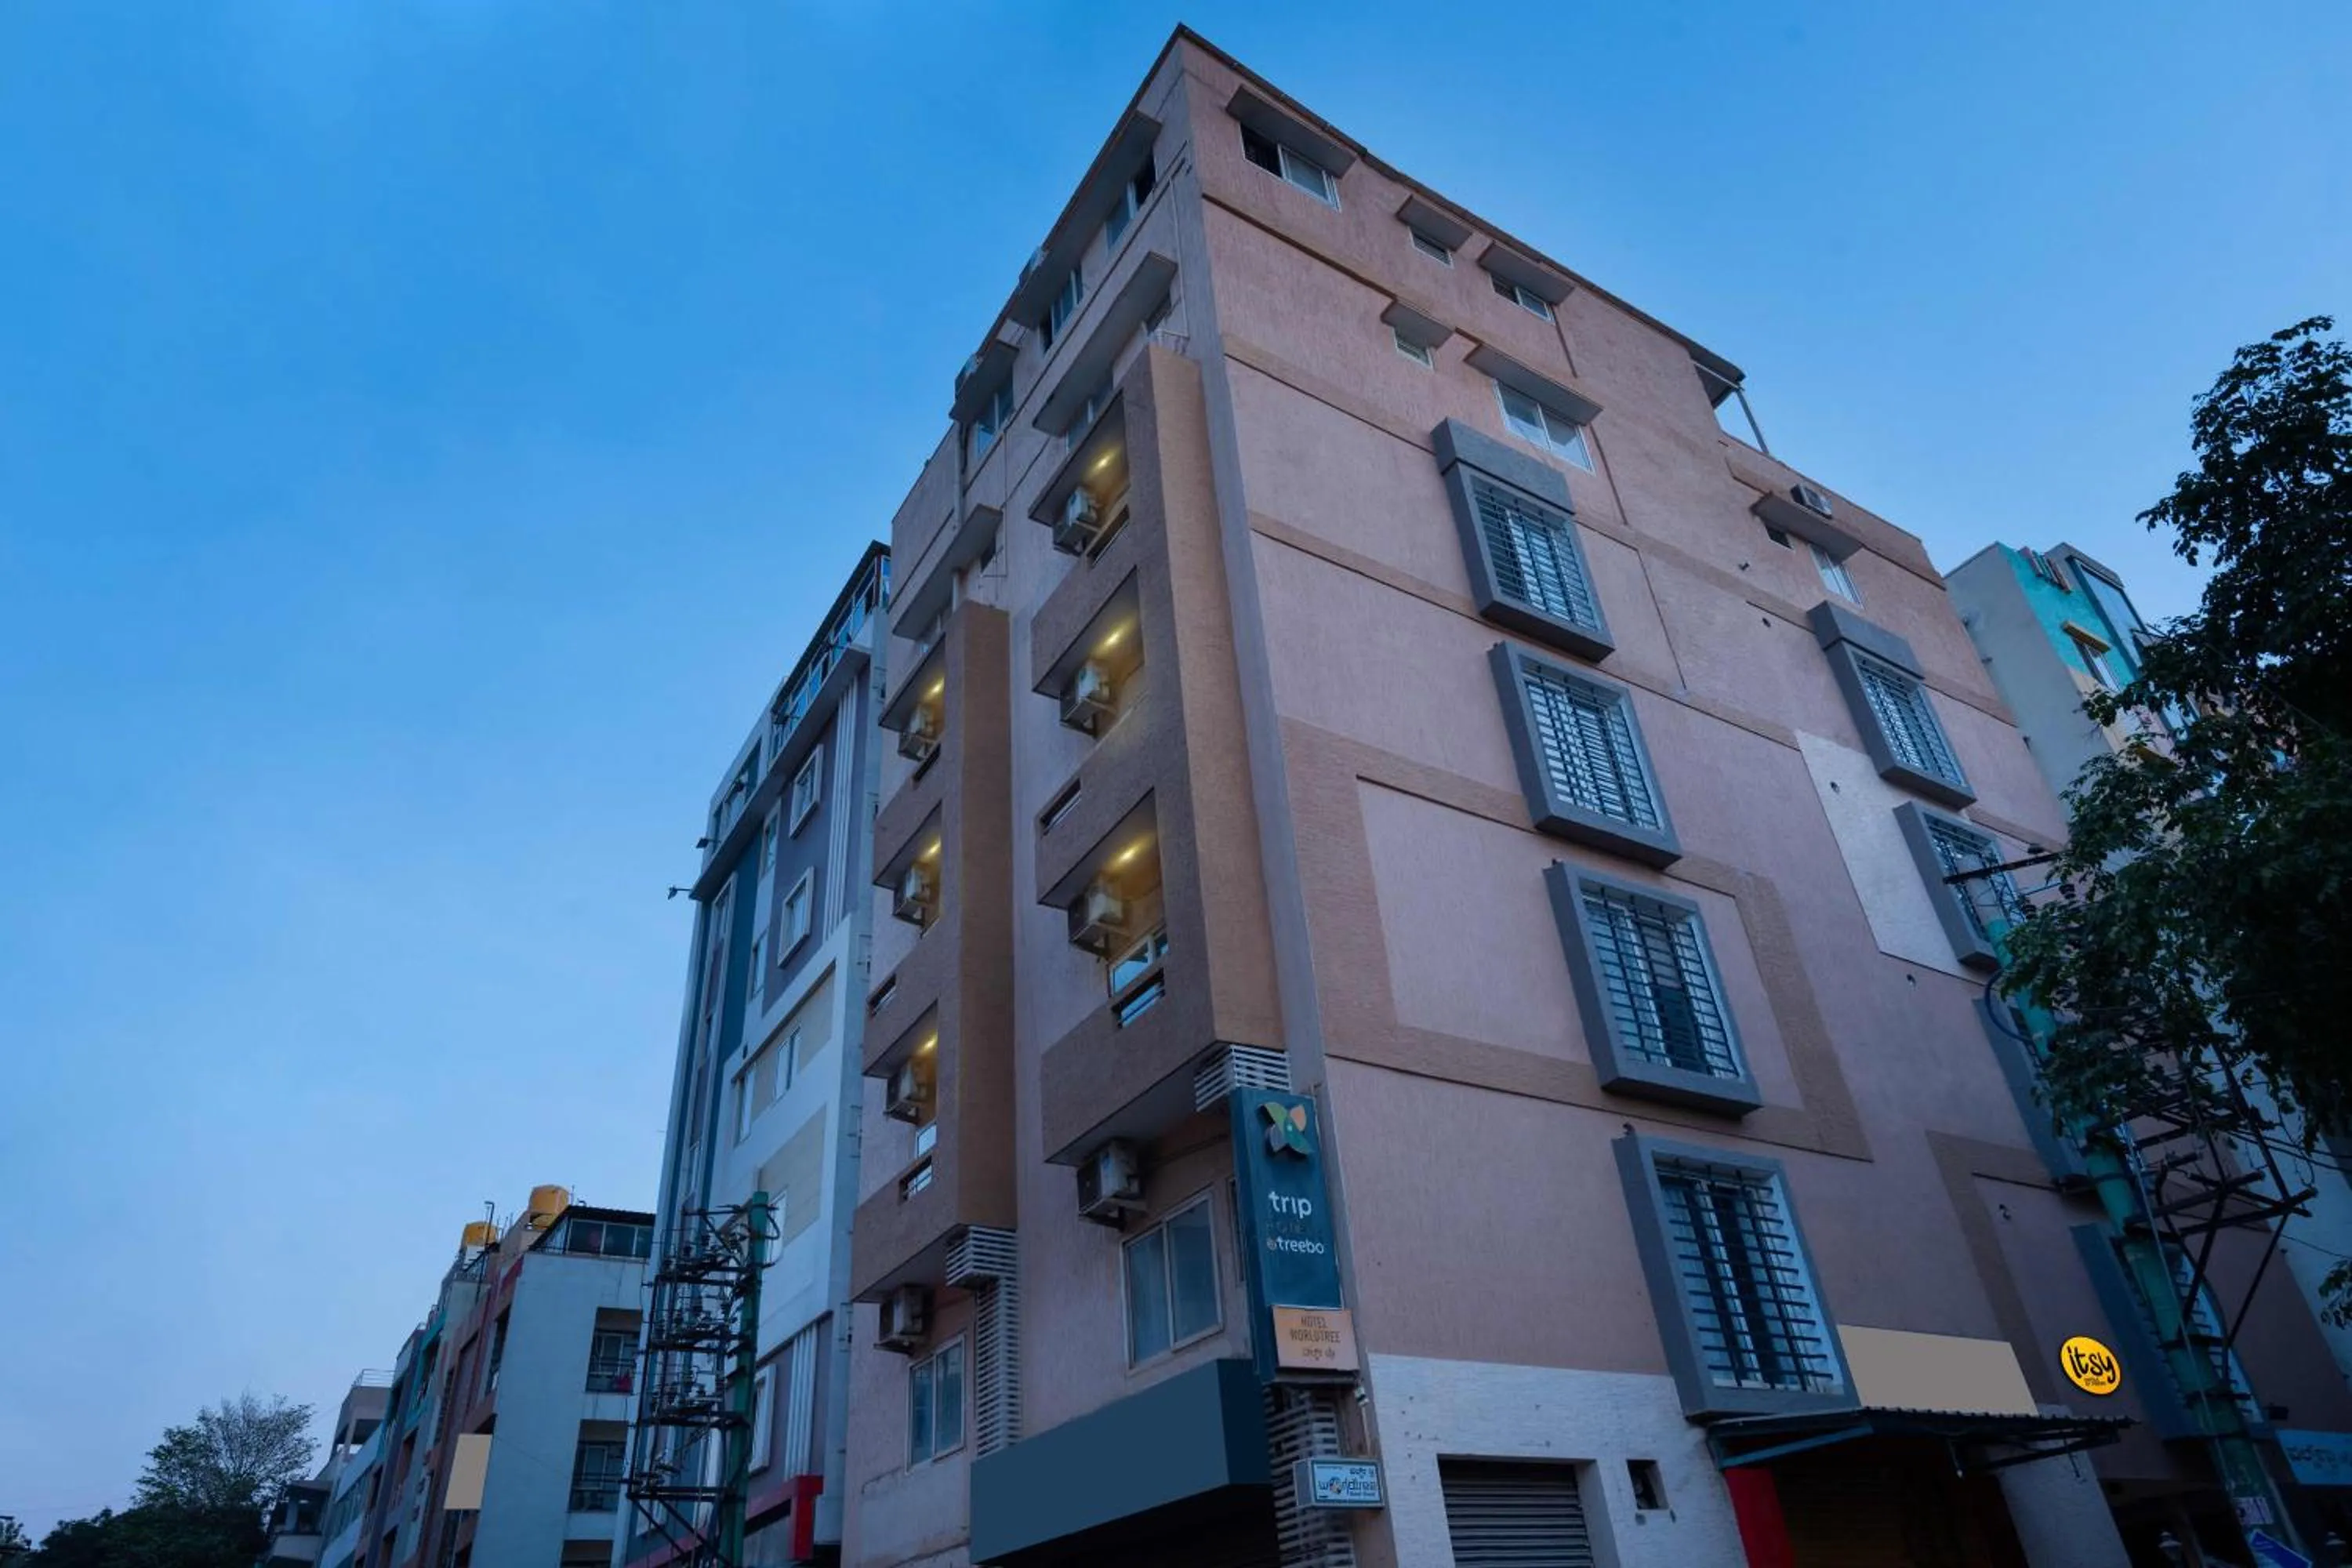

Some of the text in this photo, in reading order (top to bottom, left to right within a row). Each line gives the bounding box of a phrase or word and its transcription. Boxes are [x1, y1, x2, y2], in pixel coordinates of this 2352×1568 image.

[1268, 1191, 1312, 1219] trip
[1276, 1236, 1324, 1254] treebo
[2067, 1345, 2116, 1384] itsy
